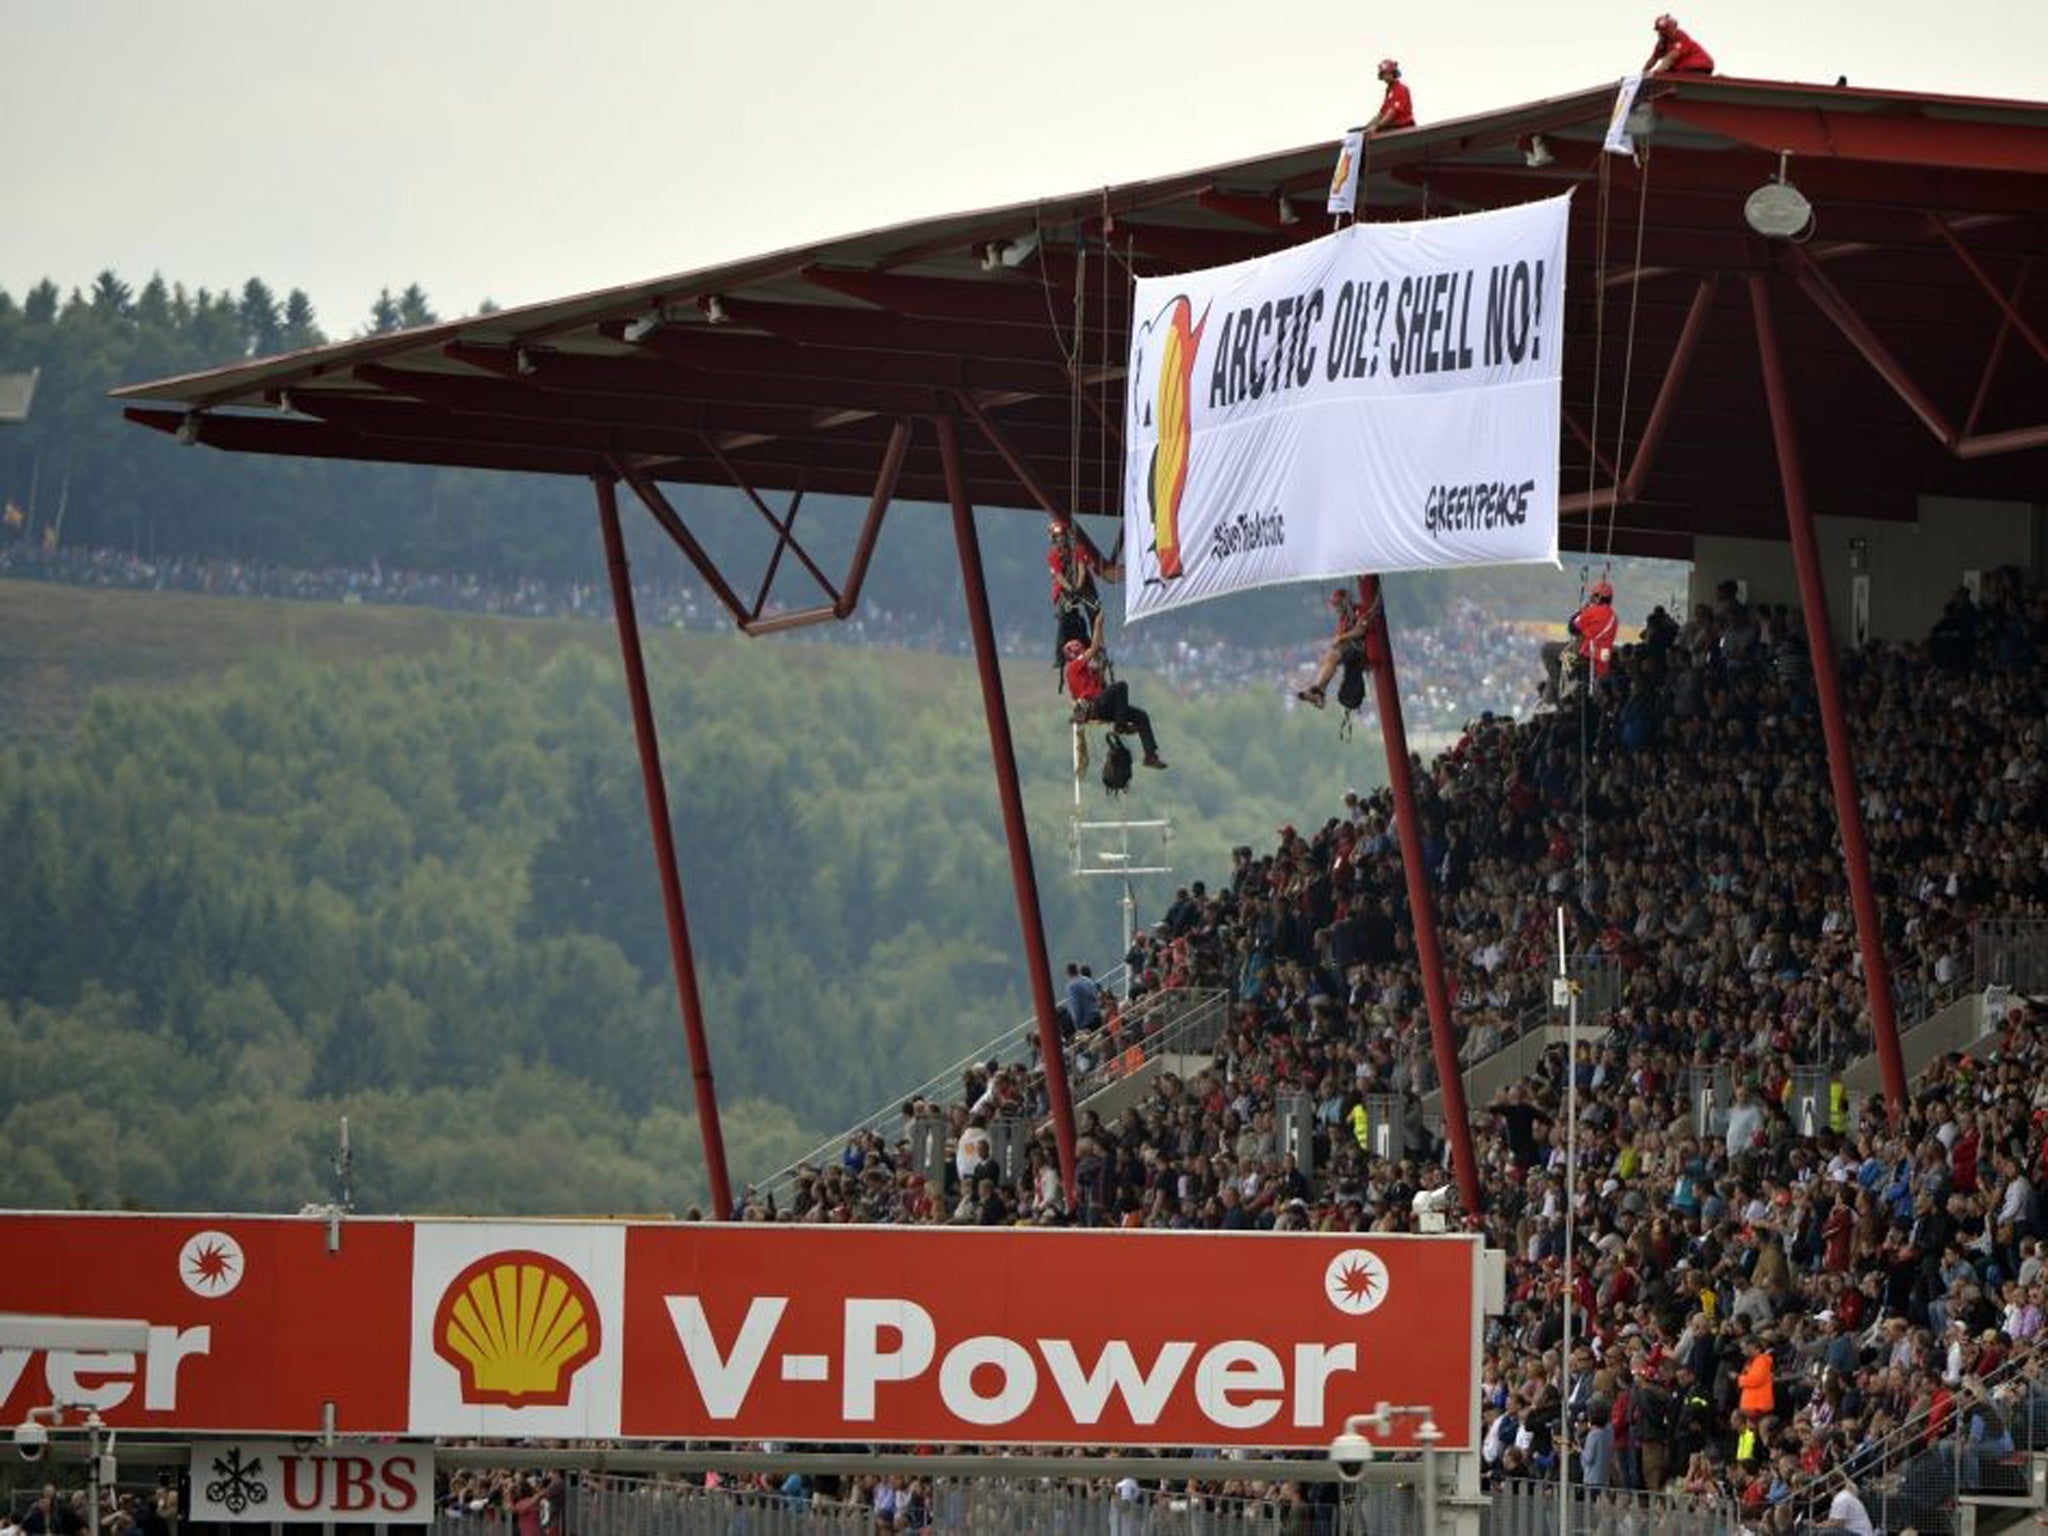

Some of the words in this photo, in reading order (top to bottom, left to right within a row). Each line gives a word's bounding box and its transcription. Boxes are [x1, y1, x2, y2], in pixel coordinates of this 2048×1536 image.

[1209, 287, 1325, 408] ARCTIC
[1327, 279, 1390, 382] OIL?
[1390, 269, 1474, 378] SHELL
[1484, 259, 1545, 366] NO!
[1424, 479, 1535, 538] GREENPEACE
[663, 1294, 1357, 1429] V-Power
[279, 1455, 418, 1512] UBS
